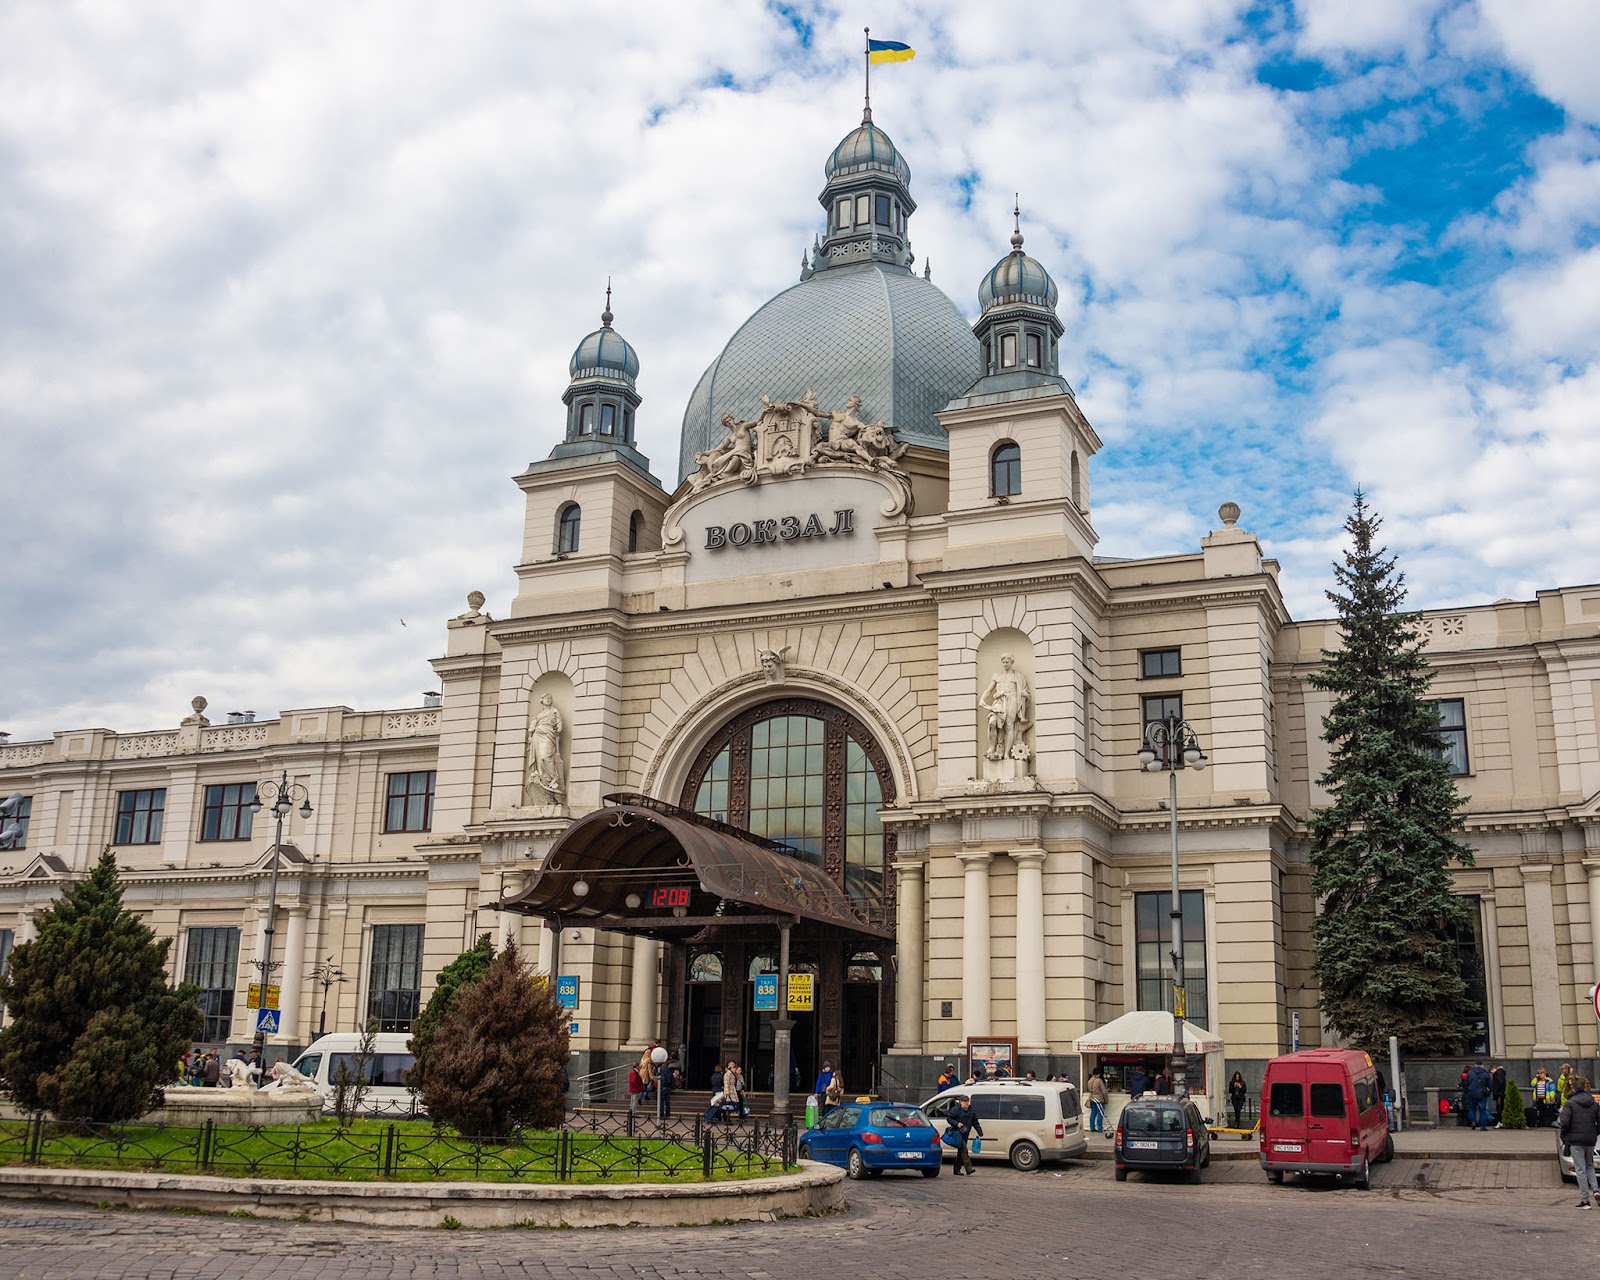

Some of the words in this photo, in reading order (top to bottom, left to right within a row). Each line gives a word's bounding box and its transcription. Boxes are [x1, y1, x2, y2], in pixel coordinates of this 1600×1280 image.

[704, 508, 855, 550] ВОКЗАЛ
[559, 985, 575, 995] 838
[757, 985, 775, 995] 838
[789, 995, 812, 1003] 24H
